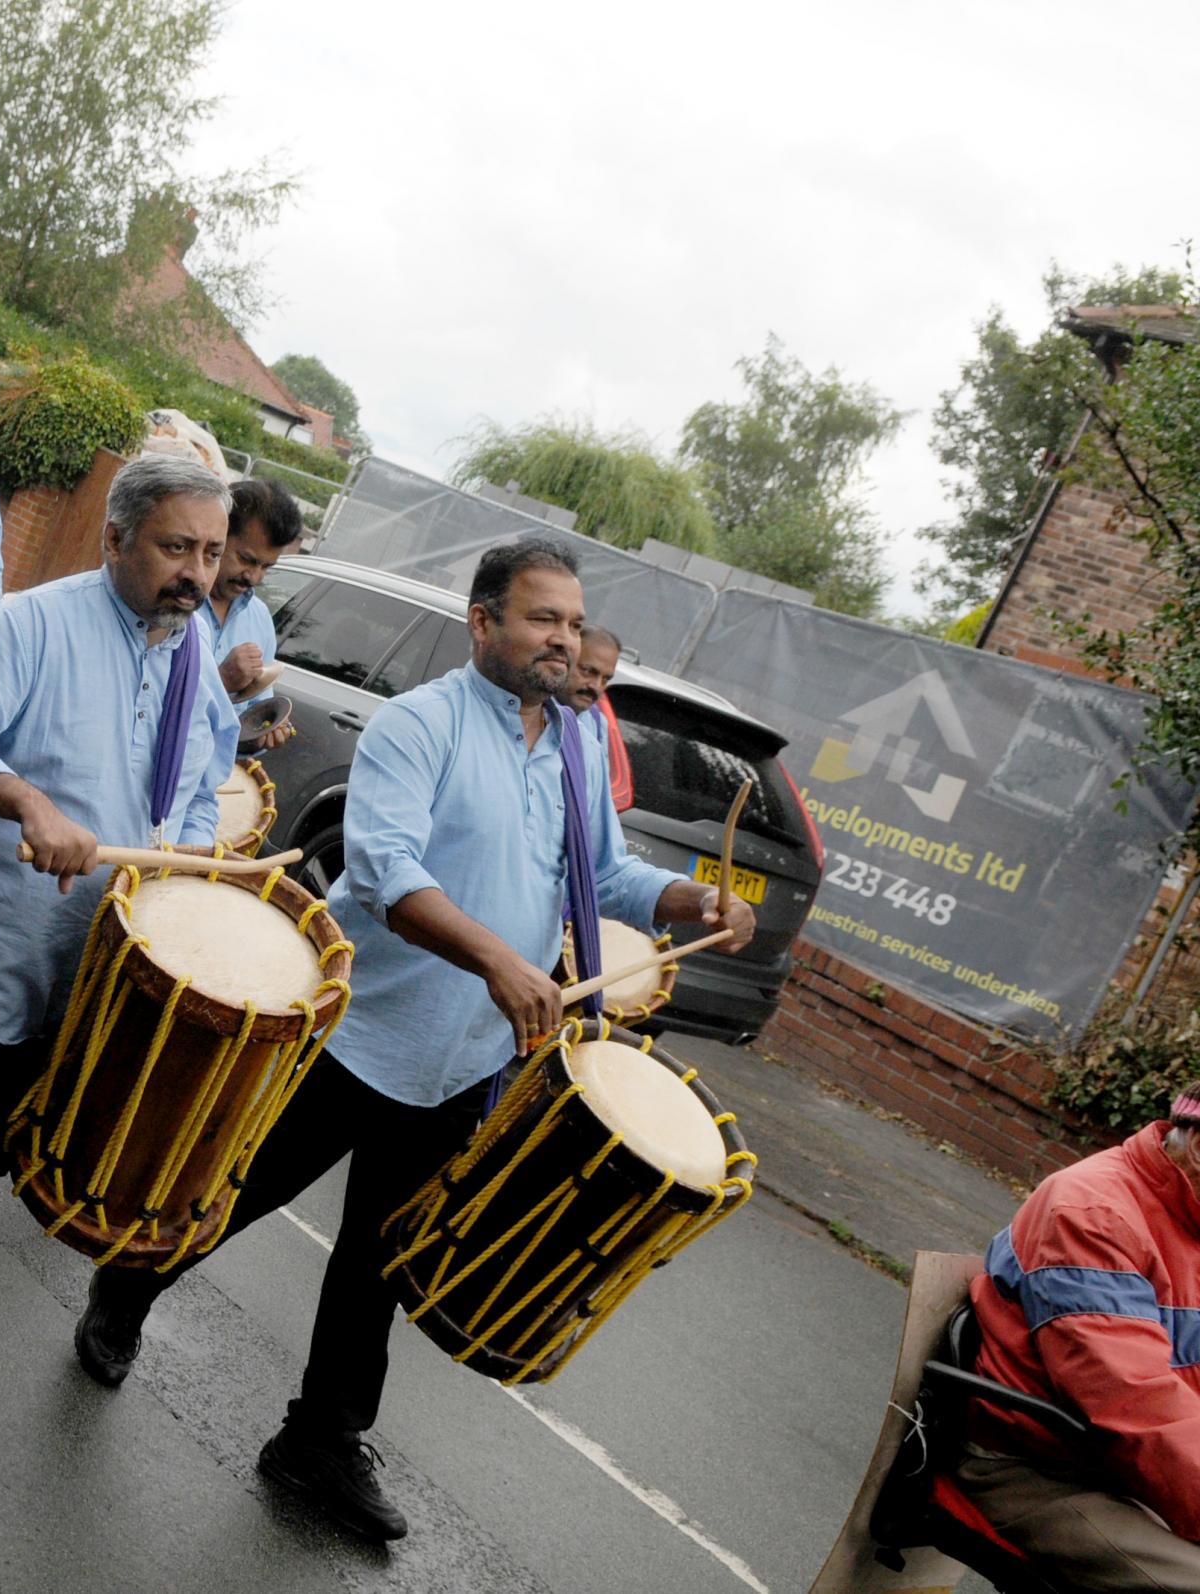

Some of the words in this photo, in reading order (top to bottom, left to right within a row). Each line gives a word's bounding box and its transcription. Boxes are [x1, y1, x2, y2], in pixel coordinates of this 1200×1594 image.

[799, 787, 975, 878] evelopments
[975, 851, 1027, 894] ltd
[825, 853, 882, 898] 233
[882, 877, 957, 926] 448
[879, 931, 954, 974] services
